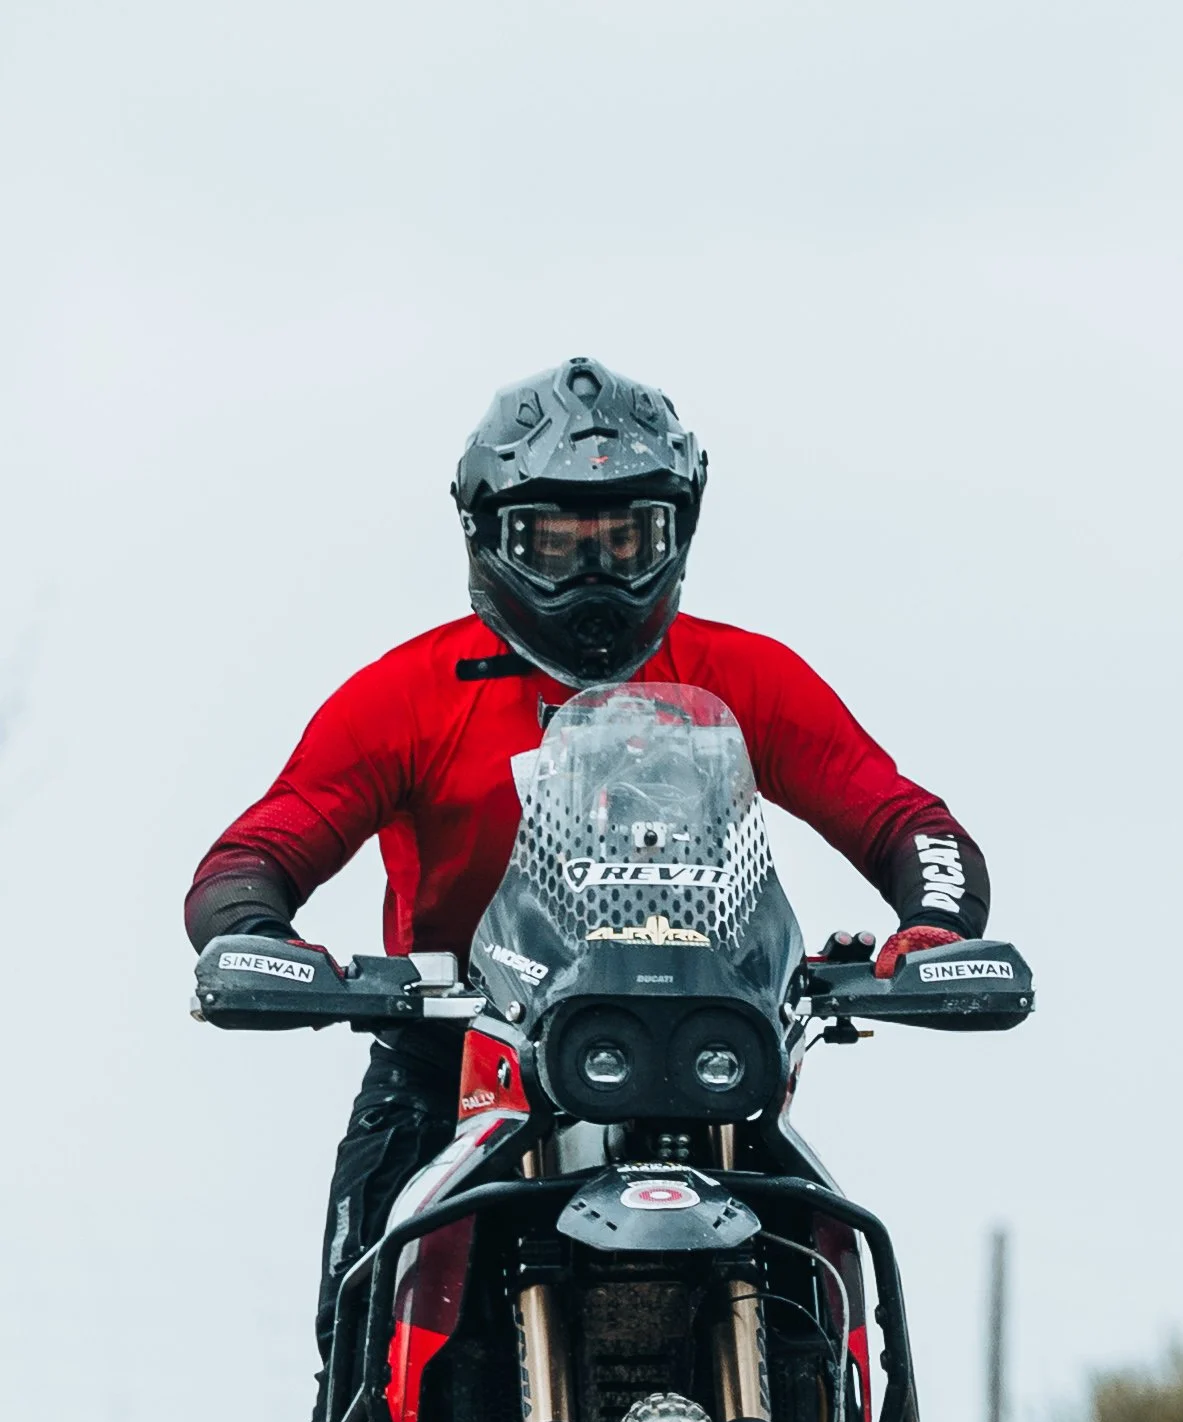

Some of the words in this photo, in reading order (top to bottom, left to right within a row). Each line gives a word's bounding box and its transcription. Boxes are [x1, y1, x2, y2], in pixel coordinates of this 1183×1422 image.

[914, 834, 965, 913] DCAT
[221, 955, 312, 980] SINEWAN
[922, 963, 1012, 980] SINEWAN
[636, 974, 674, 984] DUCATI
[461, 1091, 495, 1111] RALLY
